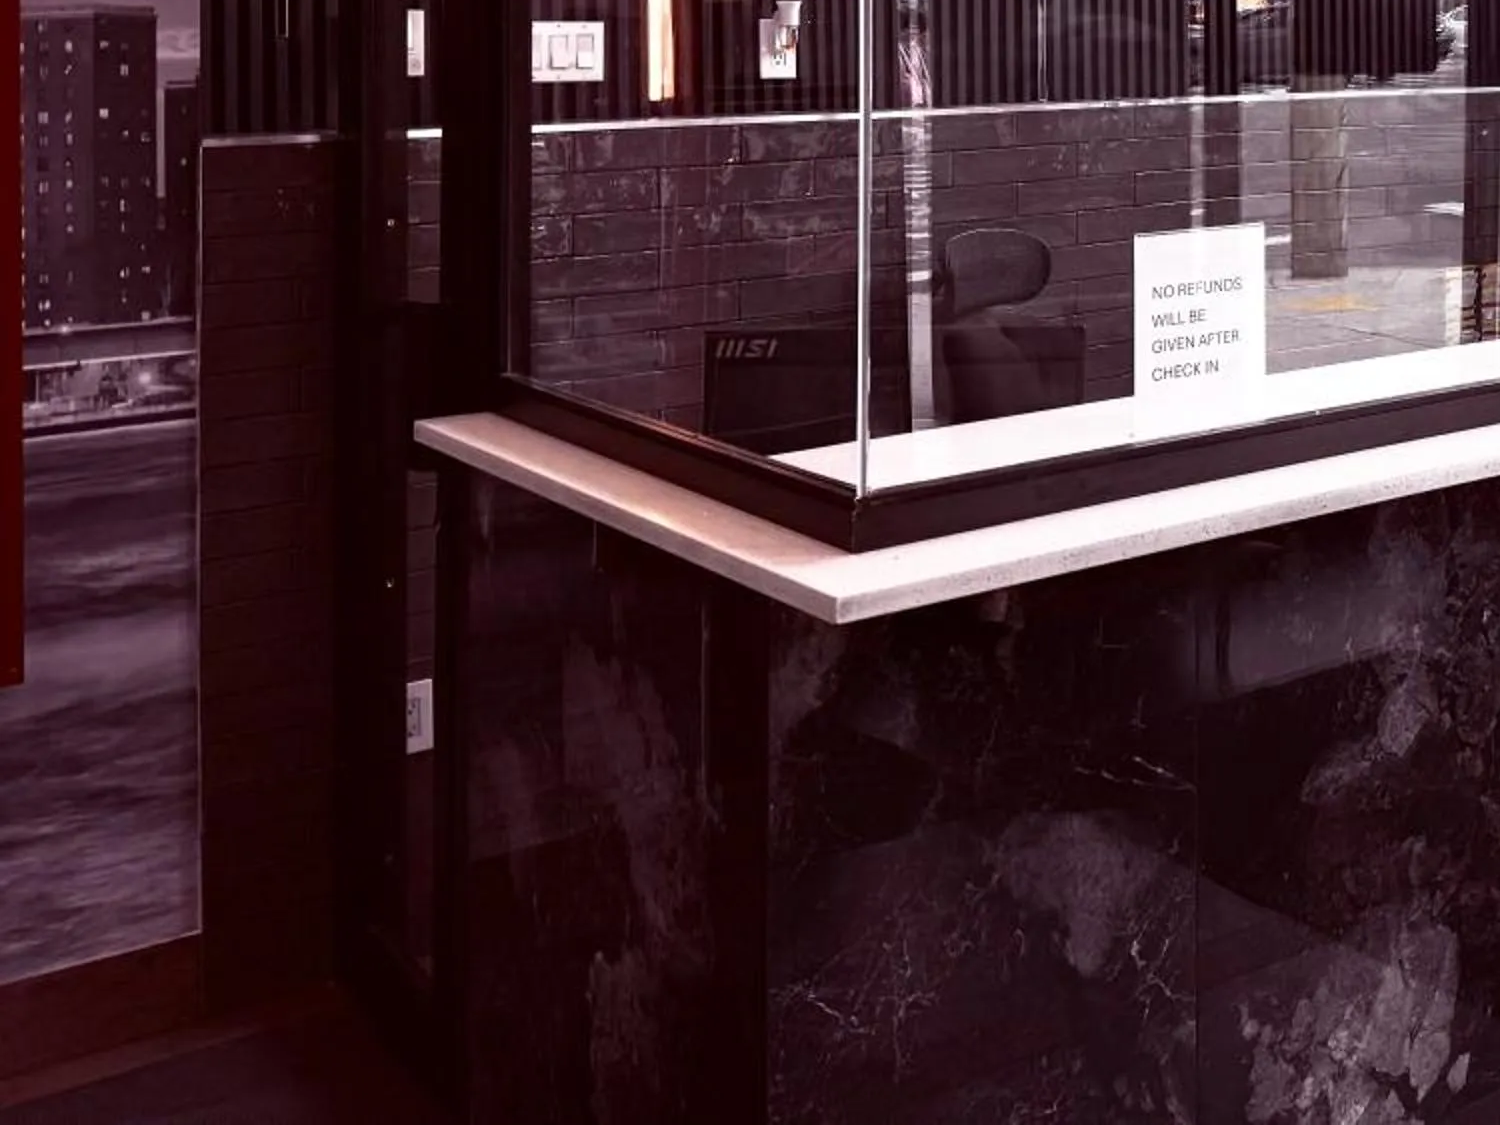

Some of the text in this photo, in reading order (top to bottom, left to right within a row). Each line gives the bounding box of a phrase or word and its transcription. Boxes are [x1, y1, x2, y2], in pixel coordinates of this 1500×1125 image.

[1151, 277, 1242, 300] NO REFUNDS
[1151, 309, 1207, 328] WILL BE
[1151, 329, 1239, 354] GIVEN AFTER
[1151, 359, 1220, 382] CHECK IN
